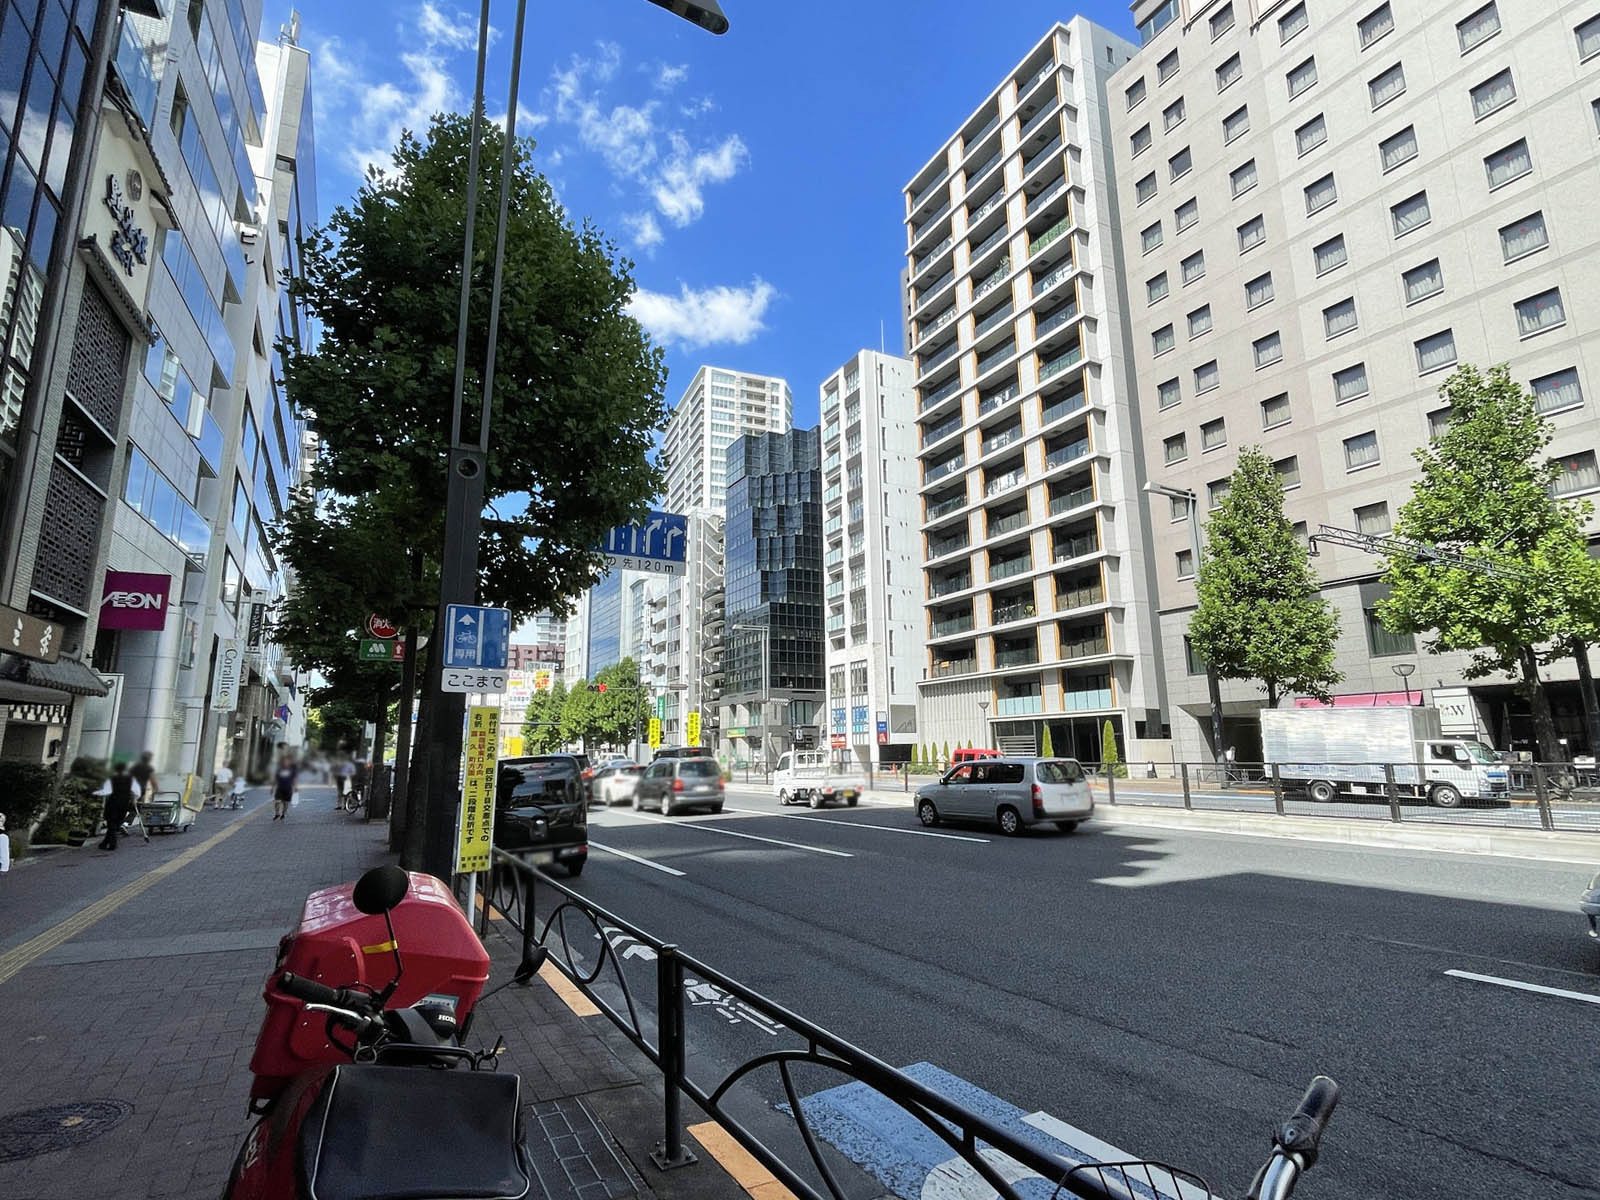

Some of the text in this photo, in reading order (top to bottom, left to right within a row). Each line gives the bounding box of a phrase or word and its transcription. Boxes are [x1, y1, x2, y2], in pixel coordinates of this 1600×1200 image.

[606, 557, 674, 572] の先120m
[220, 648, 238, 697] Corallite
[448, 674, 503, 688] ここまで
